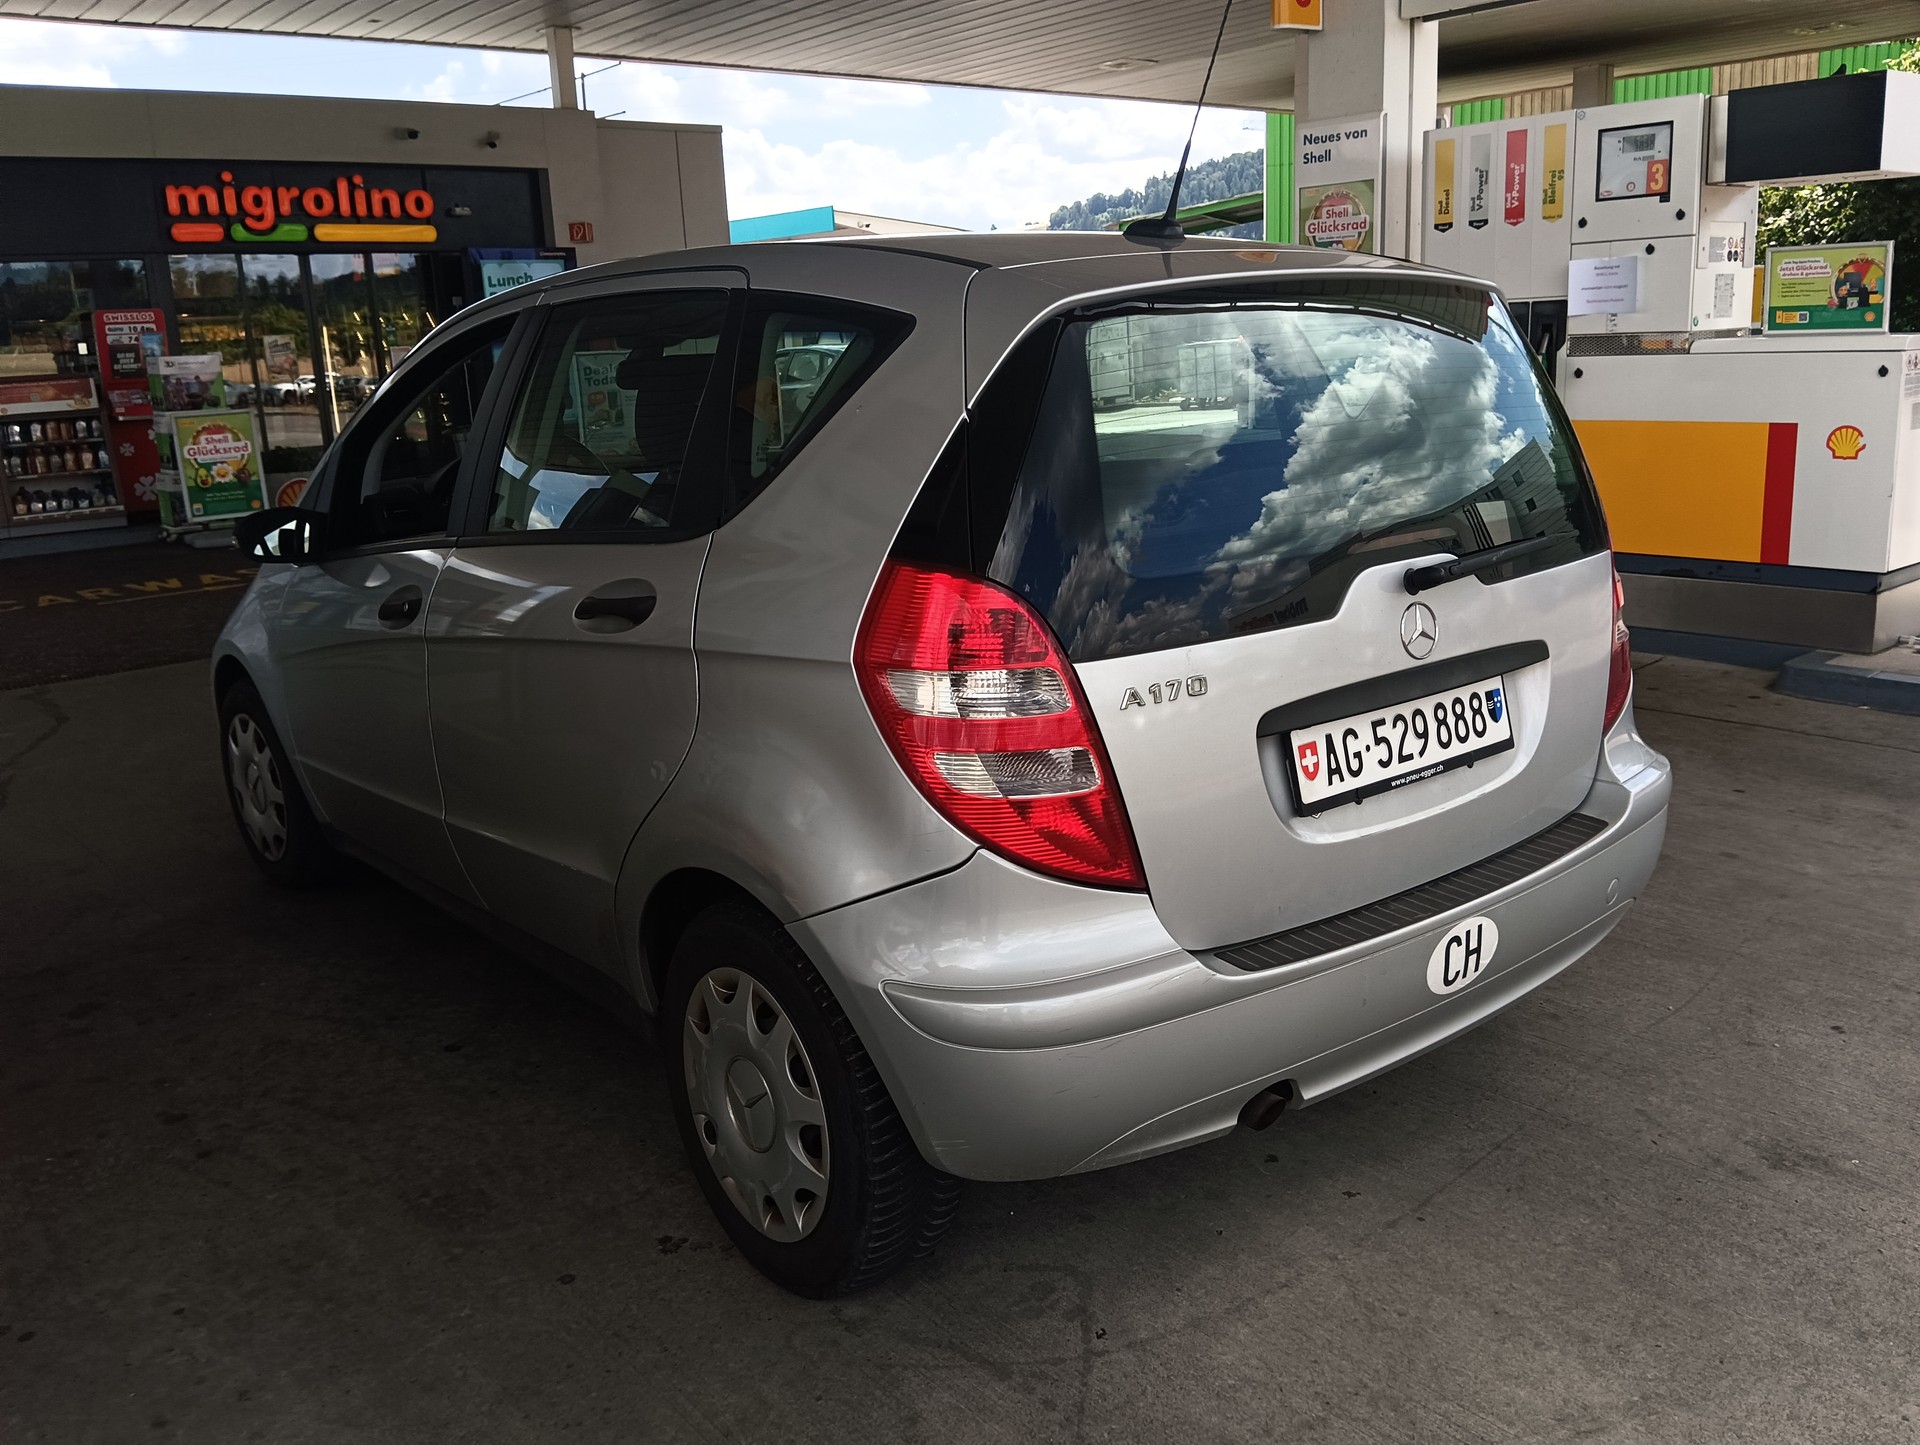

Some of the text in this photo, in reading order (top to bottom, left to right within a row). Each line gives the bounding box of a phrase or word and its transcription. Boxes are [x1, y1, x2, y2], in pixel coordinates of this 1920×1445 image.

[1303, 129, 1368, 146] Neues von
[1303, 149, 1332, 165] Shell
[1557, 169, 1565, 181] 95
[1650, 163, 1664, 190] 3
[166, 170, 434, 231] migrolino
[1326, 208, 1349, 219] Shell
[1307, 217, 1367, 234] Glücksrad
[1796, 263, 1828, 271] Glücksrad
[488, 272, 533, 287] Lunch
[104, 312, 154, 322] SWISSLOS
[584, 374, 617, 387] Toda
[205, 435, 229, 445] Shell
[187, 442, 249, 457] Glücksrad
[1390, 764, 1444, 787] www.pneu-egger.ch
[1443, 923, 1483, 987] CH
